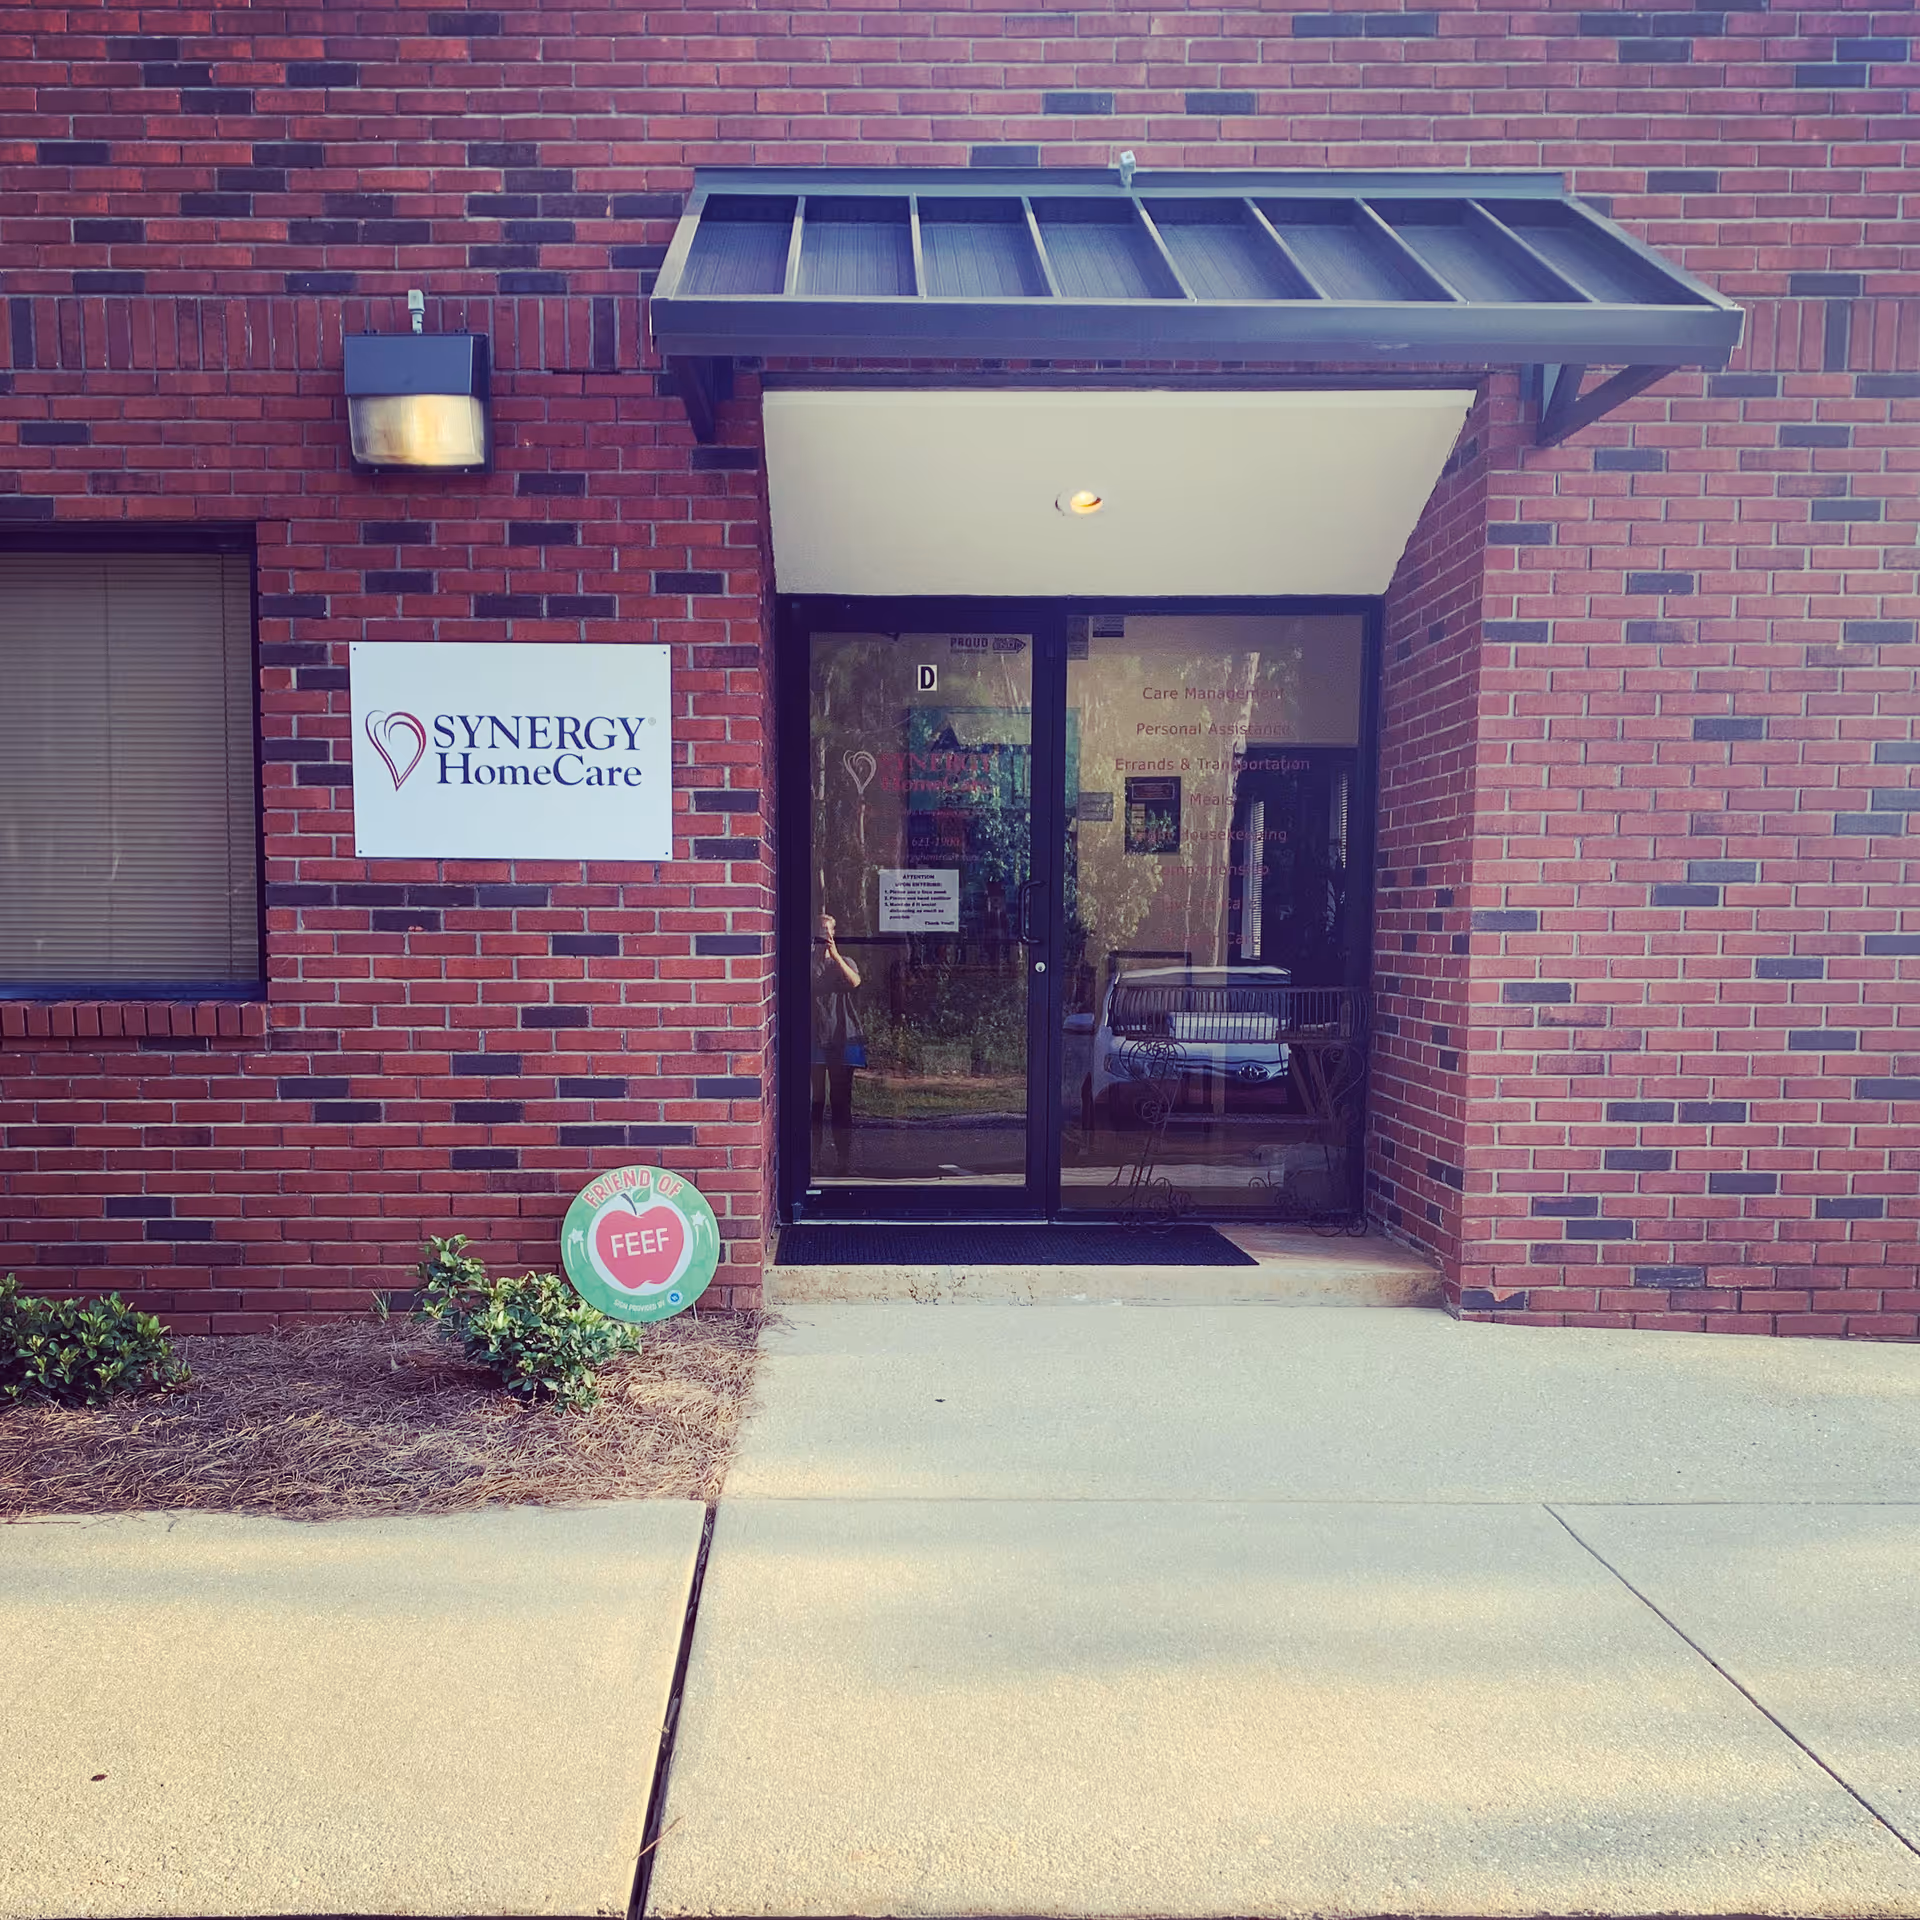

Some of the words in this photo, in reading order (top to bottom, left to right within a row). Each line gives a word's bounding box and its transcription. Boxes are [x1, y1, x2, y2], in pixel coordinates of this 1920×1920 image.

[950, 637, 989, 649] PROUD
[920, 667, 936, 689] D
[1142, 687, 1179, 700] Care
[1184, 687, 1285, 703] Management
[433, 714, 646, 751] SYNERGY
[1136, 722, 1202, 736] Personal
[1208, 722, 1290, 736] Assistance
[436, 752, 643, 787] HomeCare
[1115, 757, 1175, 771] Errands
[1180, 758, 1191, 771] &
[1190, 793, 1235, 807] Meals
[582, 1169, 652, 1209] FRIEND
[656, 1174, 684, 1198] OF
[610, 1227, 670, 1259] FEEF
